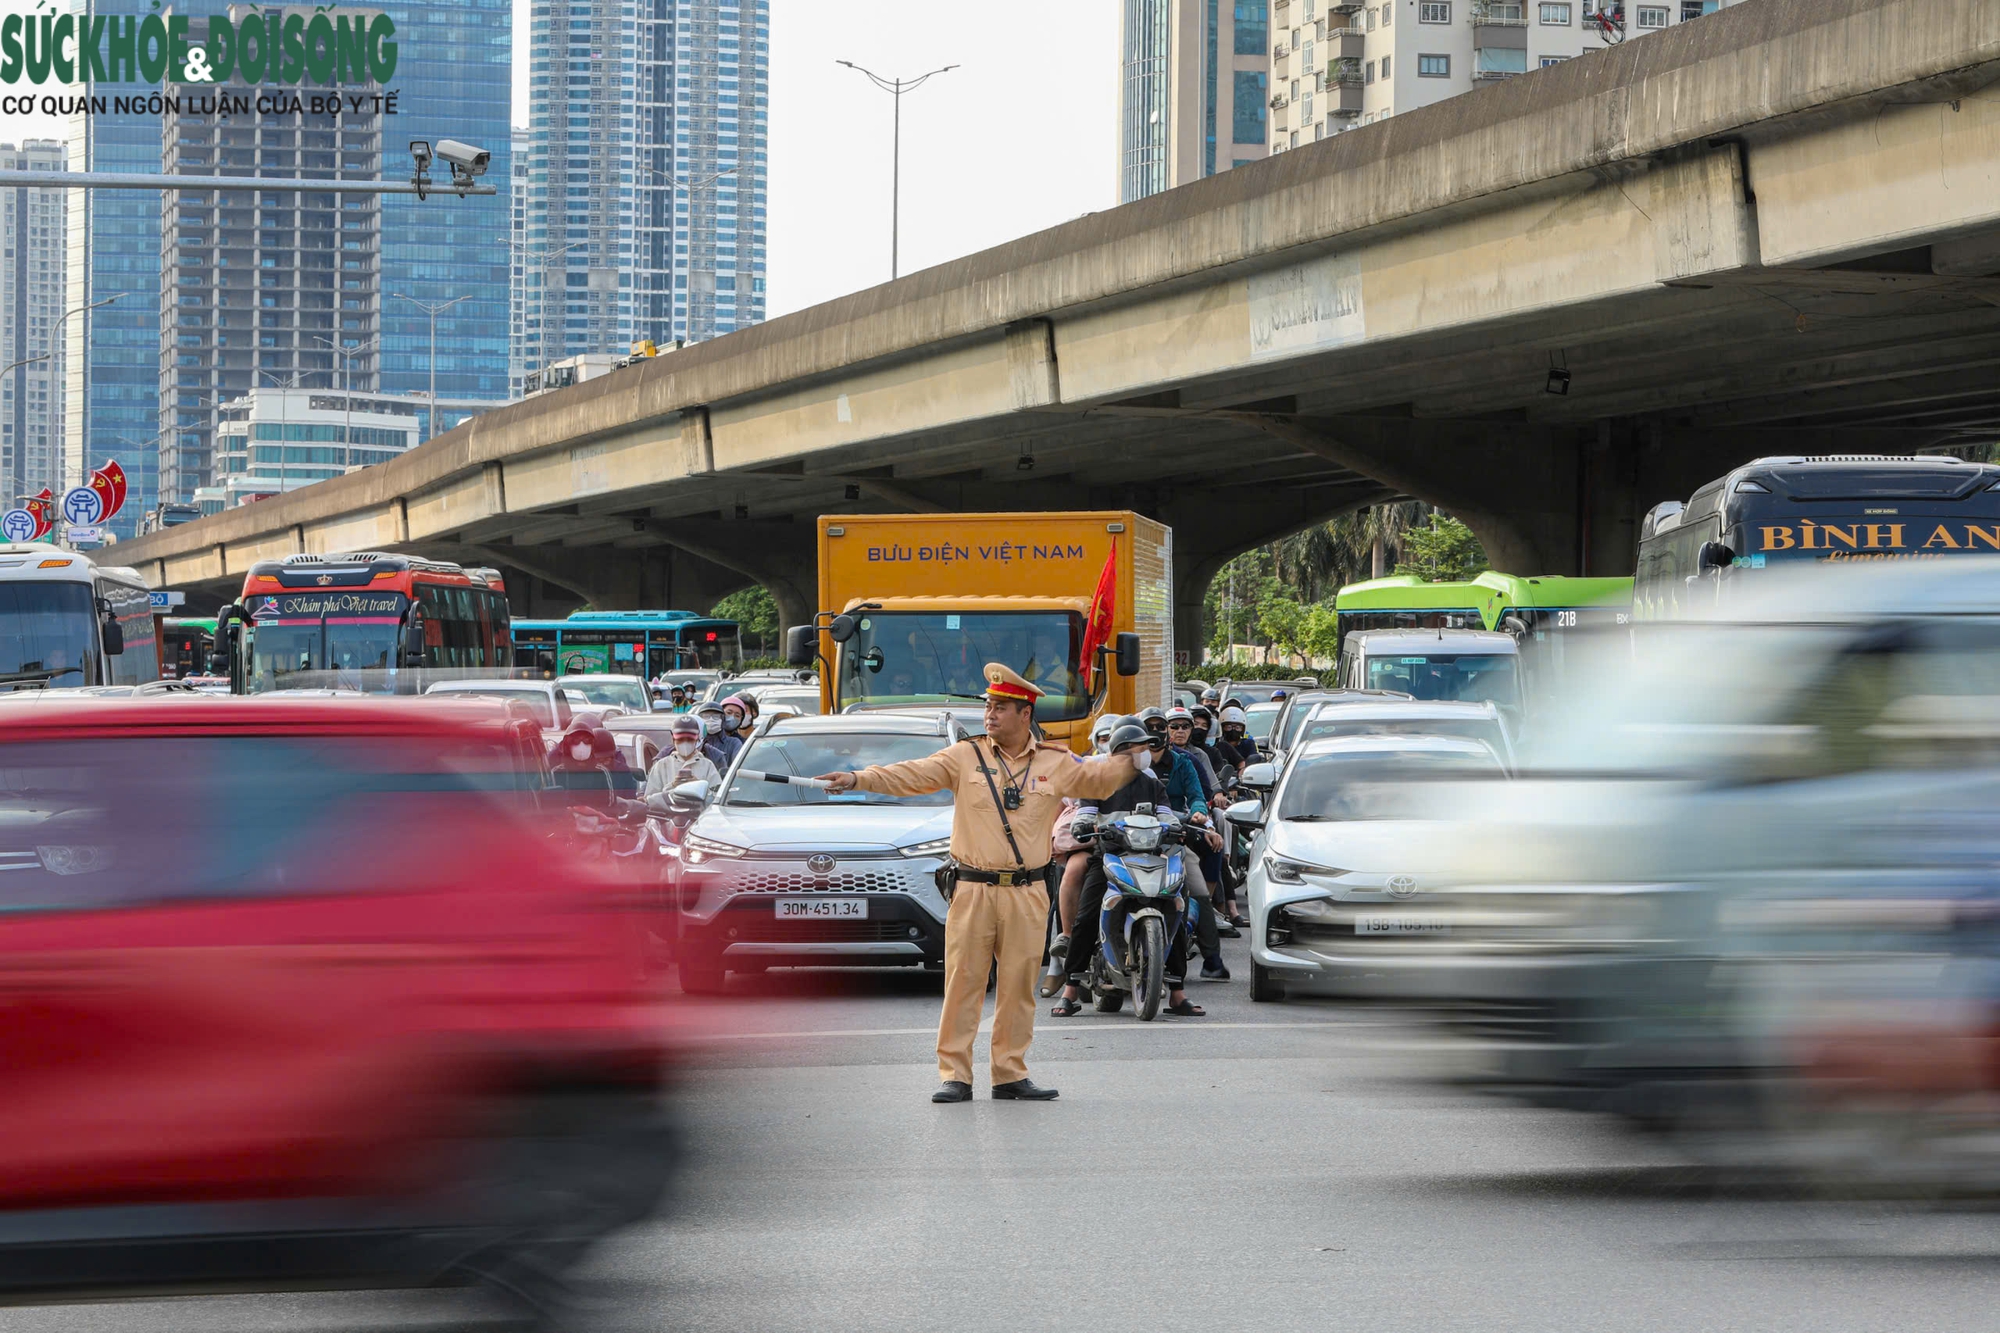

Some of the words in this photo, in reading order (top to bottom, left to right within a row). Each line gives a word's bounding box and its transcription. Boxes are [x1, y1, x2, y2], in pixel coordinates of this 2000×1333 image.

[1759, 519, 1906, 550] BÌNH
[1921, 524, 2000, 551] AN
[868, 544, 912, 561] BƯU
[918, 542, 969, 565] ĐIỆN
[978, 541, 1027, 564] VIỆT
[1033, 545, 1083, 559] NAM
[284, 597, 320, 613] Khám
[320, 596, 340, 618] phá
[341, 595, 368, 614] Việt
[369, 597, 398, 612] travel
[1558, 611, 1576, 626] 21B
[783, 903, 859, 915] 30M-451.34
